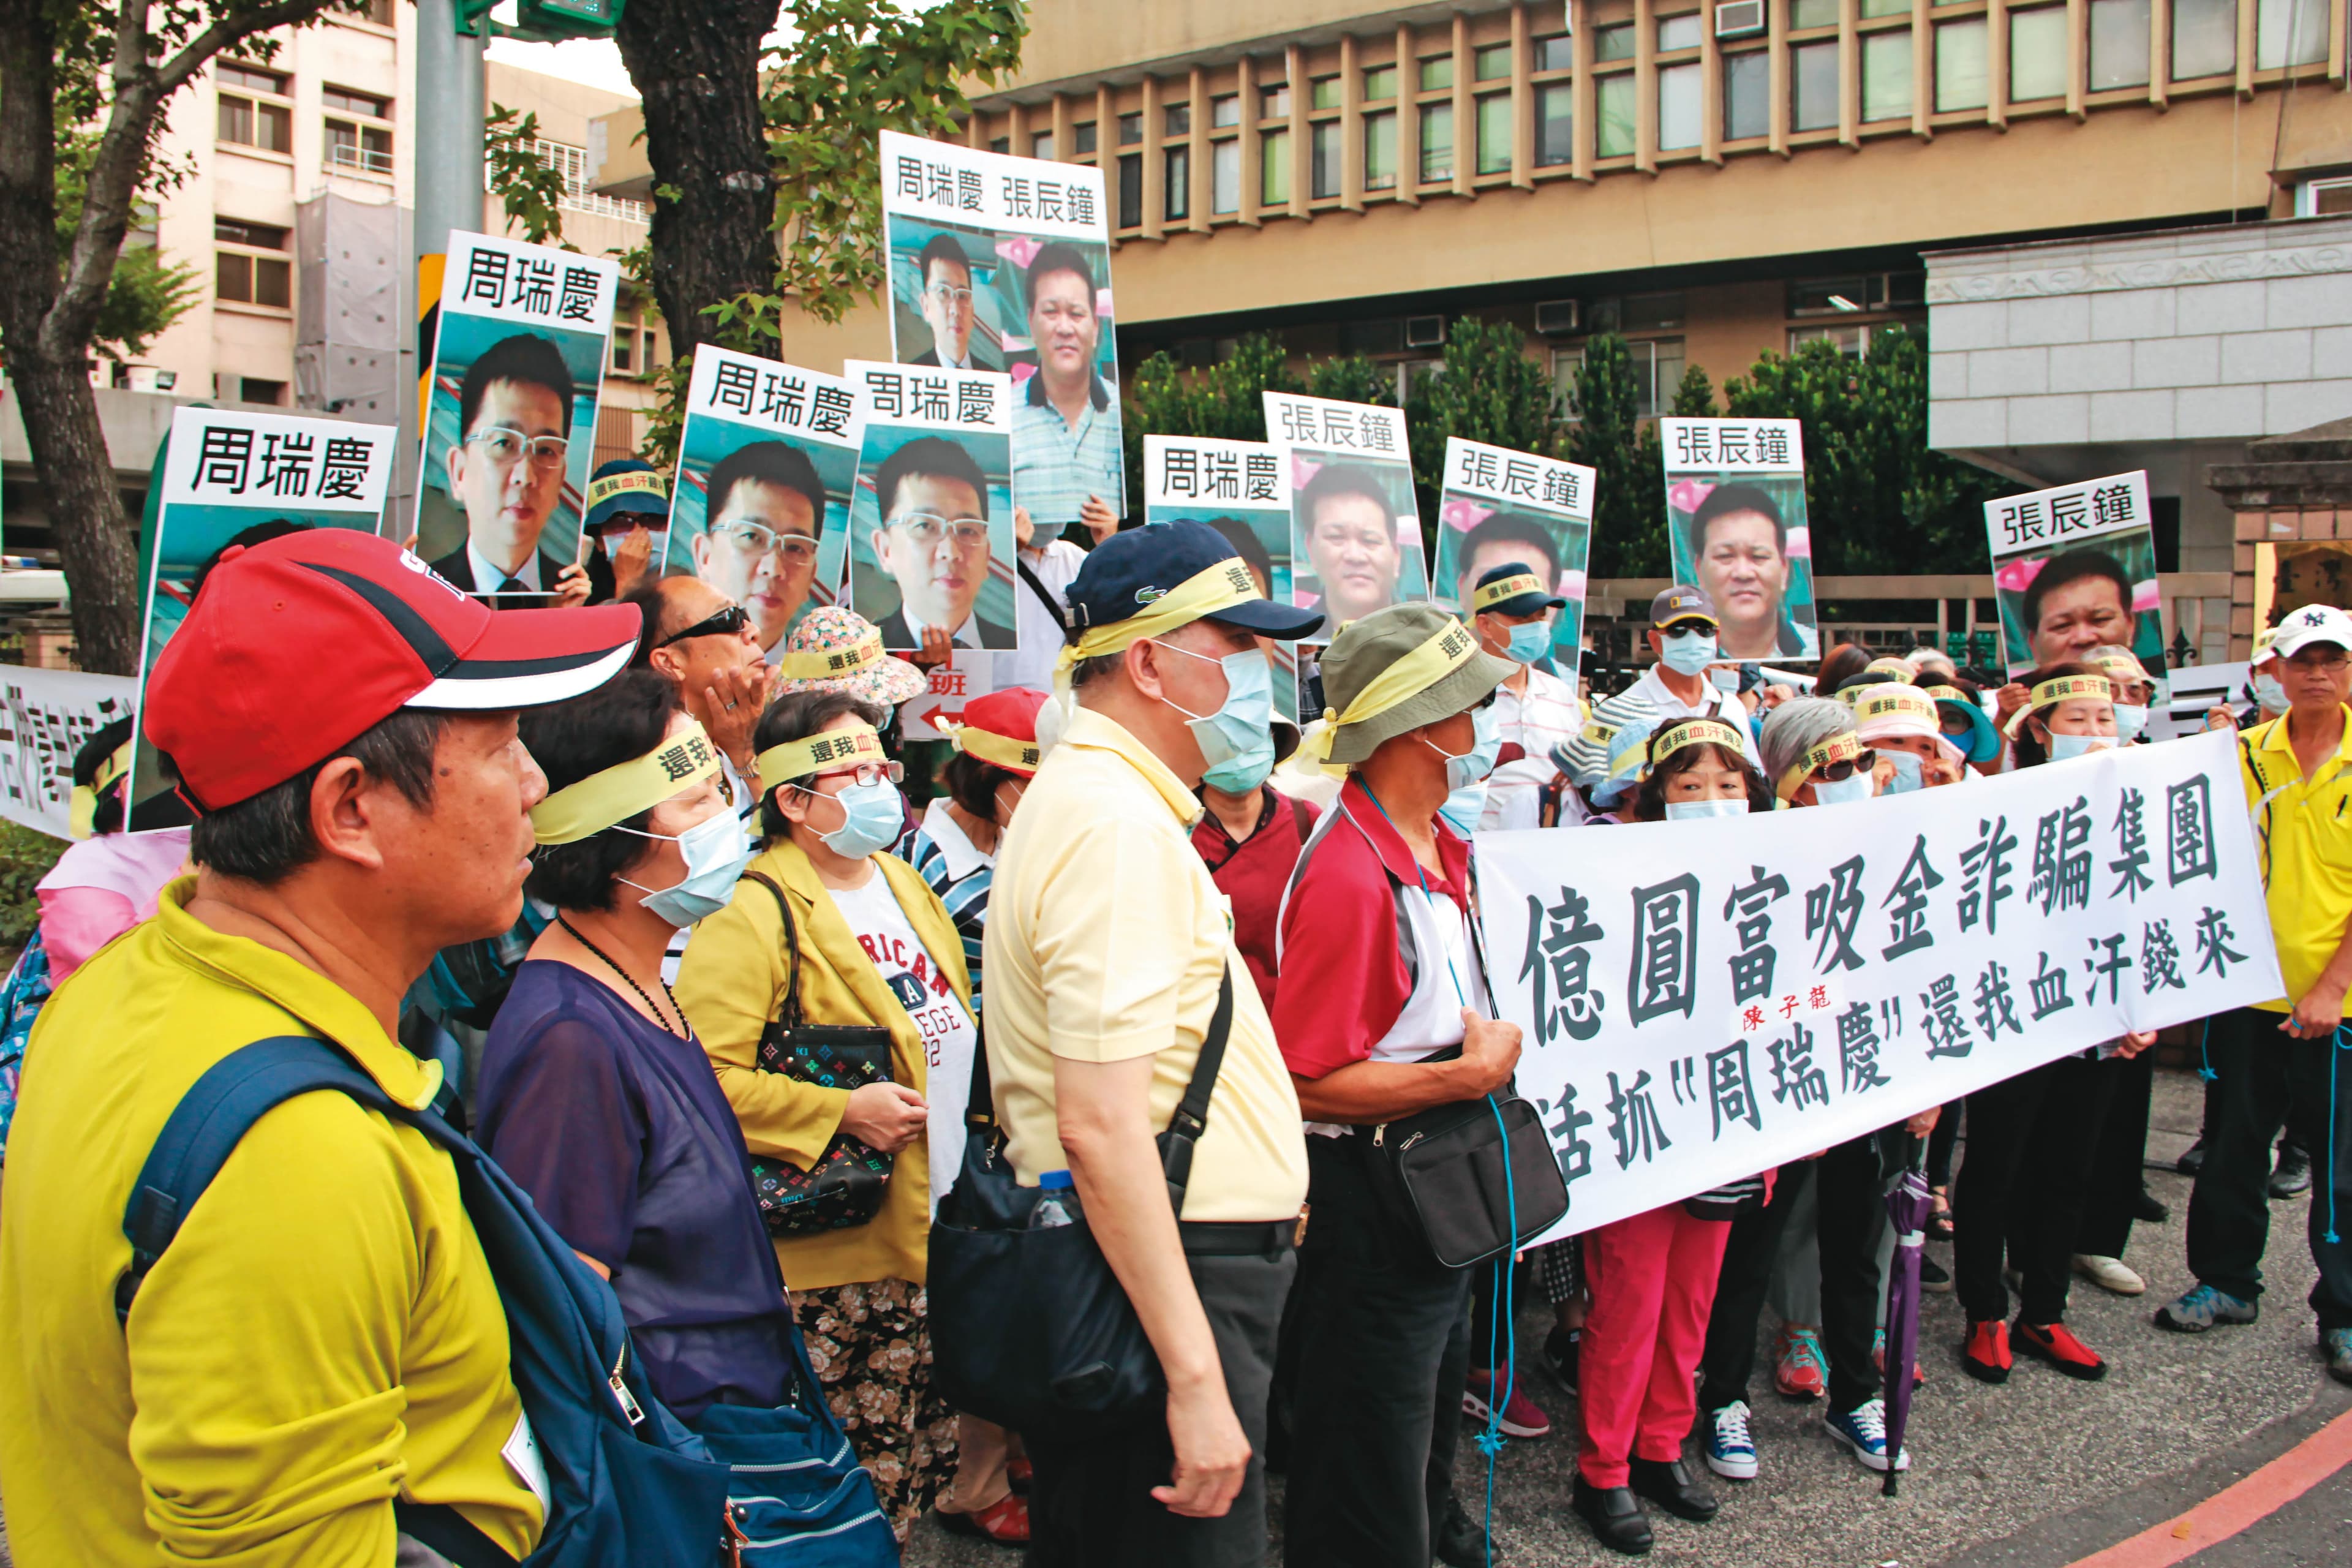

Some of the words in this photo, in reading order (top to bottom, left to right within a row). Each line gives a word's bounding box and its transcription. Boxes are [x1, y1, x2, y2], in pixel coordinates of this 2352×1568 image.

[897, 155, 984, 213] 周瑞慶
[1002, 176, 1096, 226] 張辰鐘
[462, 247, 601, 323] 周瑞慶
[709, 360, 855, 439] 周瑞慶
[865, 371, 995, 425] 周瑞慶
[1280, 402, 1396, 453] 張辰鐘
[190, 426, 374, 500] 周瑞慶
[1163, 448, 1279, 502] 周瑞慶
[1676, 426, 1790, 464] 張辰鐘
[1461, 448, 1580, 509] 張辰鐘
[2000, 483, 2136, 545] 張辰鐘
[2303, 611, 2327, 627] NY
[1518, 771, 2218, 1047] 億圓富吸金詐騙集團
